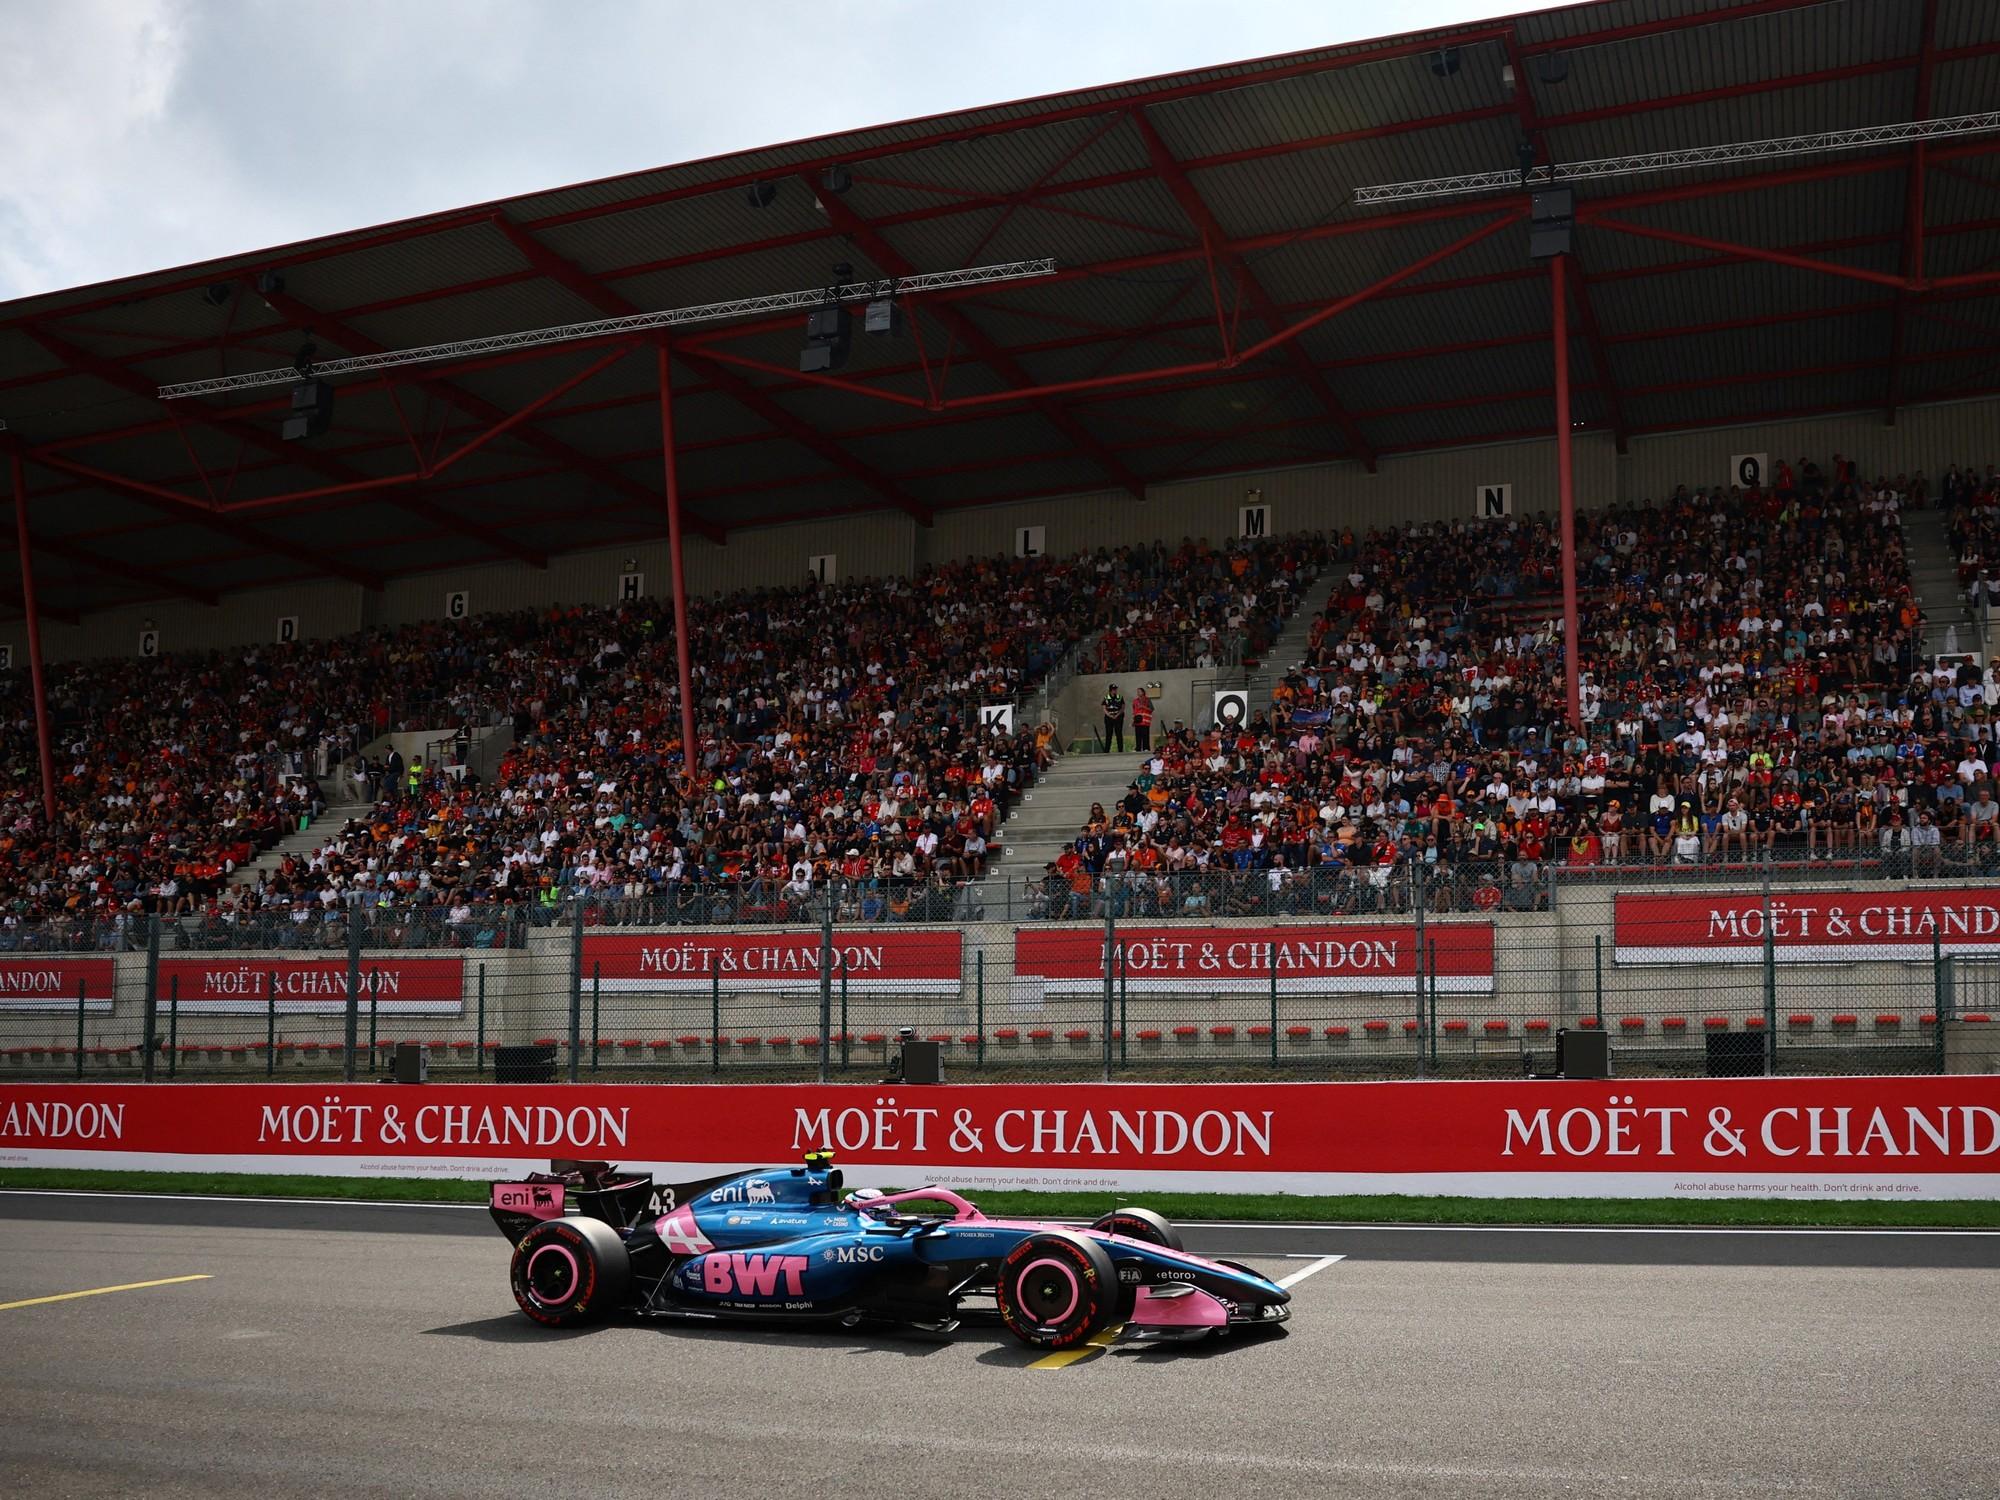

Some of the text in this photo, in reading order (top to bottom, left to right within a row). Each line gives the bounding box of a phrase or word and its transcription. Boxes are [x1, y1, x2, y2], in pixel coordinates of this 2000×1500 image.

[1485, 487, 1503, 516] N
[1246, 508, 1264, 536] M
[1023, 530, 1036, 555] L
[625, 576, 638, 601] H
[451, 594, 463, 617] G
[282, 620, 293, 641] D
[143, 633, 154, 655] C
[986, 709, 1007, 733] K
[1708, 902, 1817, 938] MOËT
[1826, 907, 1852, 937] &
[640, 942, 716, 972] MOËT
[720, 947, 738, 972] &
[1199, 943, 1220, 970] &
[1227, 941, 1398, 970] CHANDON
[204, 967, 265, 994] MOËT
[258, 1096, 631, 1147] MOËT & CHANDON
[791, 1098, 1274, 1156] MOËT & CHANDON
[1502, 1096, 1688, 1156] MOËT
[1704, 1107, 1747, 1157] &
[360, 1163, 380, 1171] Alcohol
[710, 1182, 742, 1203] eni
[925, 1175, 950, 1183] Alcohol
[951, 1175, 973, 1184] abuse
[974, 1176, 996, 1184] harms
[997, 1178, 1014, 1186] your
[1015, 1176, 1040, 1185] health.
[1062, 1177, 1082, 1186] drink
[1083, 1178, 1098, 1186] and
[1099, 1178, 1120, 1187] drive.
[1674, 1182, 1706, 1191] Alcohol
[1708, 1183, 1735, 1192] abuse
[1737, 1183, 1766, 1192] harms
[1768, 1185, 1788, 1193] your
[1791, 1183, 1821, 1192] health.
[1850, 1183, 1874, 1192] drink
[1876, 1184, 1893, 1192] and
[1896, 1184, 1922, 1193] drive.
[501, 1188, 529, 1206] eni
[648, 1188, 675, 1215] 43
[837, 1246, 884, 1263] MSC
[704, 1253, 809, 1296] BWT
[785, 1301, 813, 1310] Delphi
